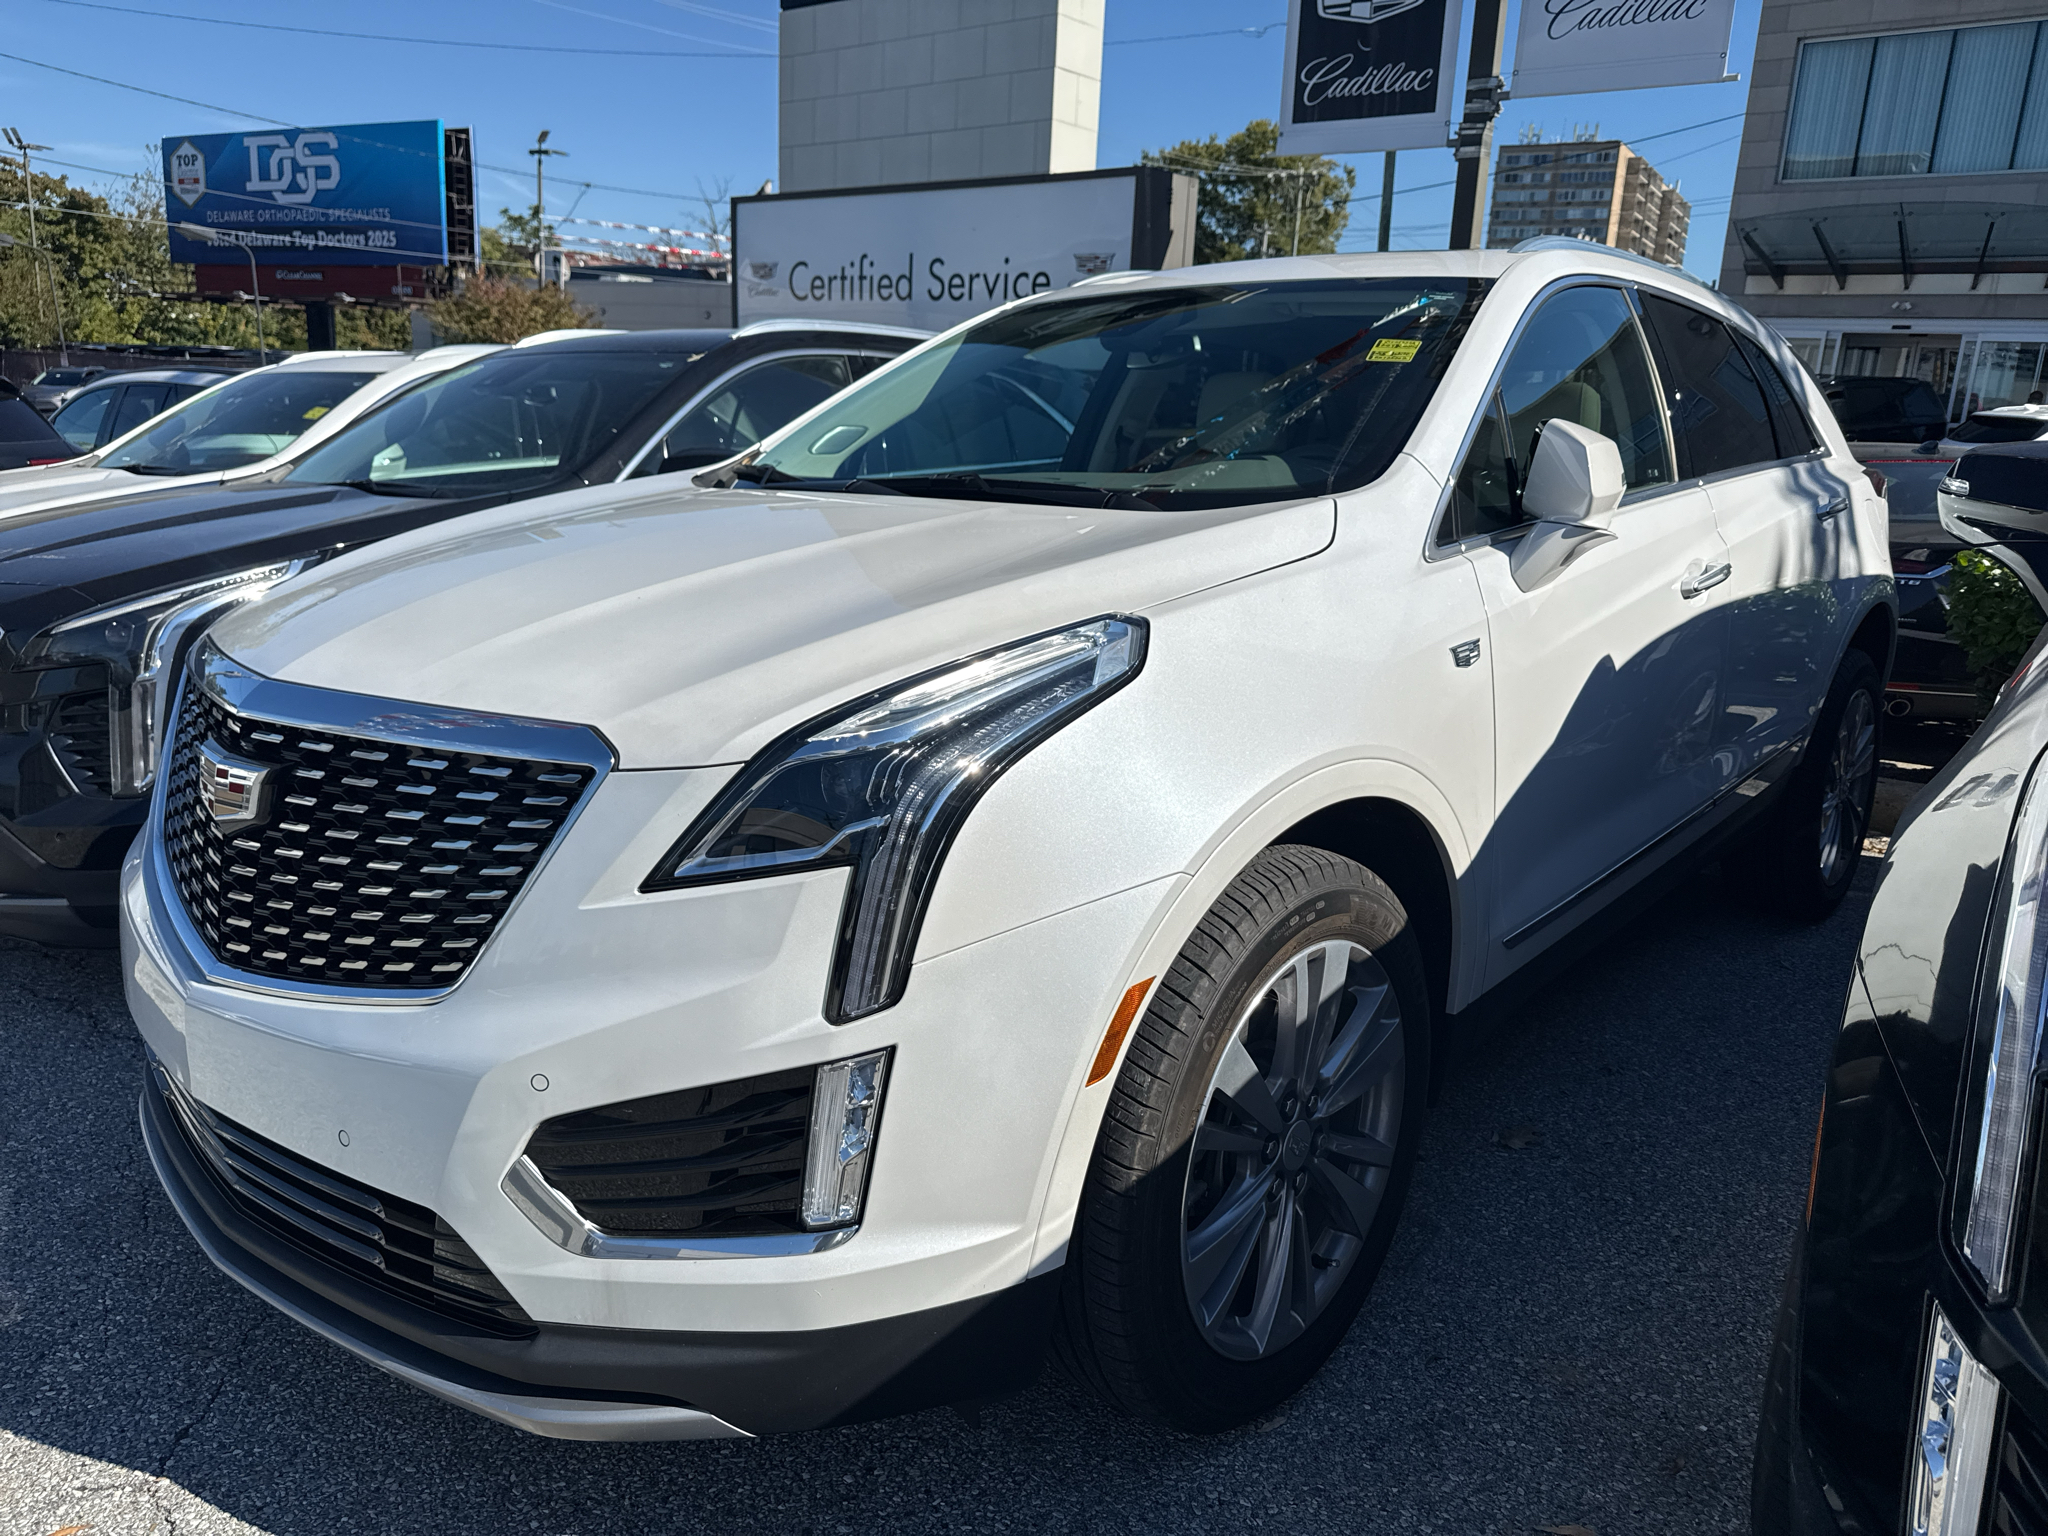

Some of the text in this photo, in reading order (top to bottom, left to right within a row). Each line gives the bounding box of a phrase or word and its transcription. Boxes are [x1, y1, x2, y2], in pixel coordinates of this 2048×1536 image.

[1544, 0, 1706, 40] Cadillac
[1300, 54, 1433, 106] Cadillac
[176, 154, 199, 168] TOP
[207, 207, 391, 223] DELAWARE ORTHOPAEDIC SPECIALISTS
[239, 230, 291, 247] Delaware
[292, 230, 316, 251] Top
[317, 230, 365, 247] Doctors
[367, 229, 397, 247] 2025
[789, 253, 1051, 302] Certified Service
[1210, 987, 1236, 1029] MICHELIN
